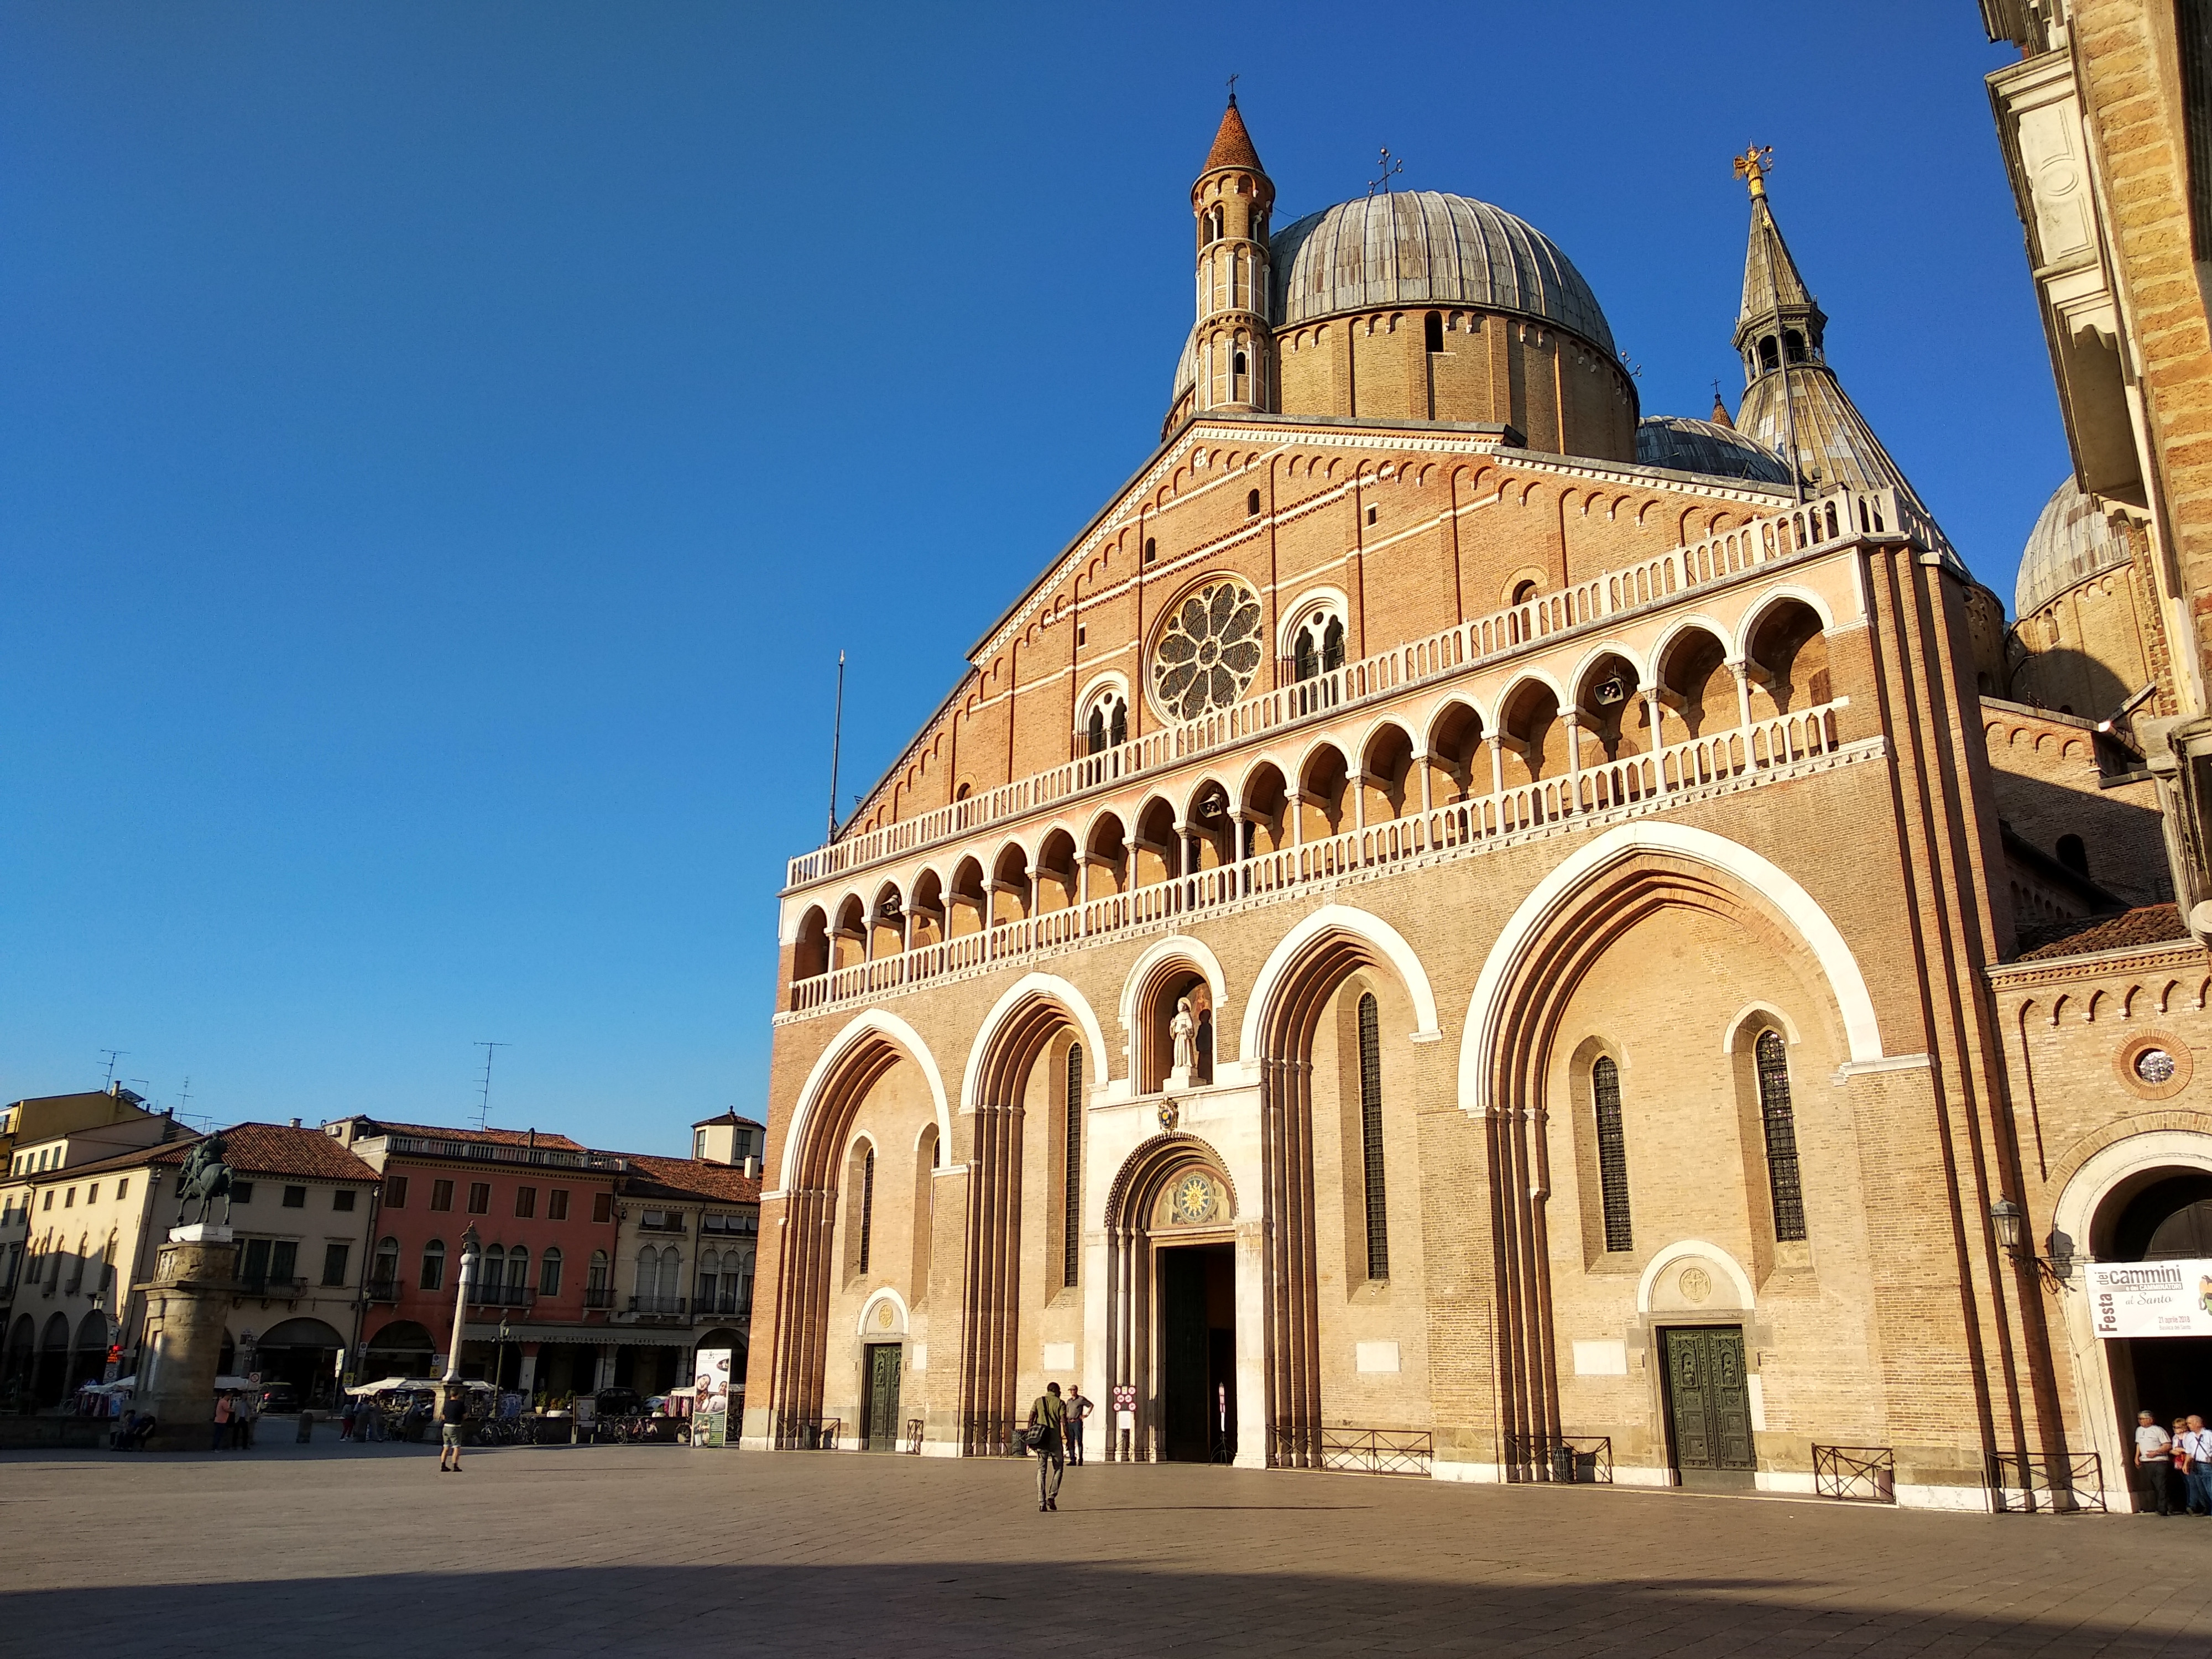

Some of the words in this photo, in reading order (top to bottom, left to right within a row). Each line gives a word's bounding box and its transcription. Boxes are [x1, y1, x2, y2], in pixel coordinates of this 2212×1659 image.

[2094, 1272, 2109, 1285] dei
[2109, 1265, 2182, 1284] cammini
[2125, 1295, 2133, 1305] al
[2137, 1292, 2172, 1305] Santo
[2098, 1293, 2117, 1331] Festa
